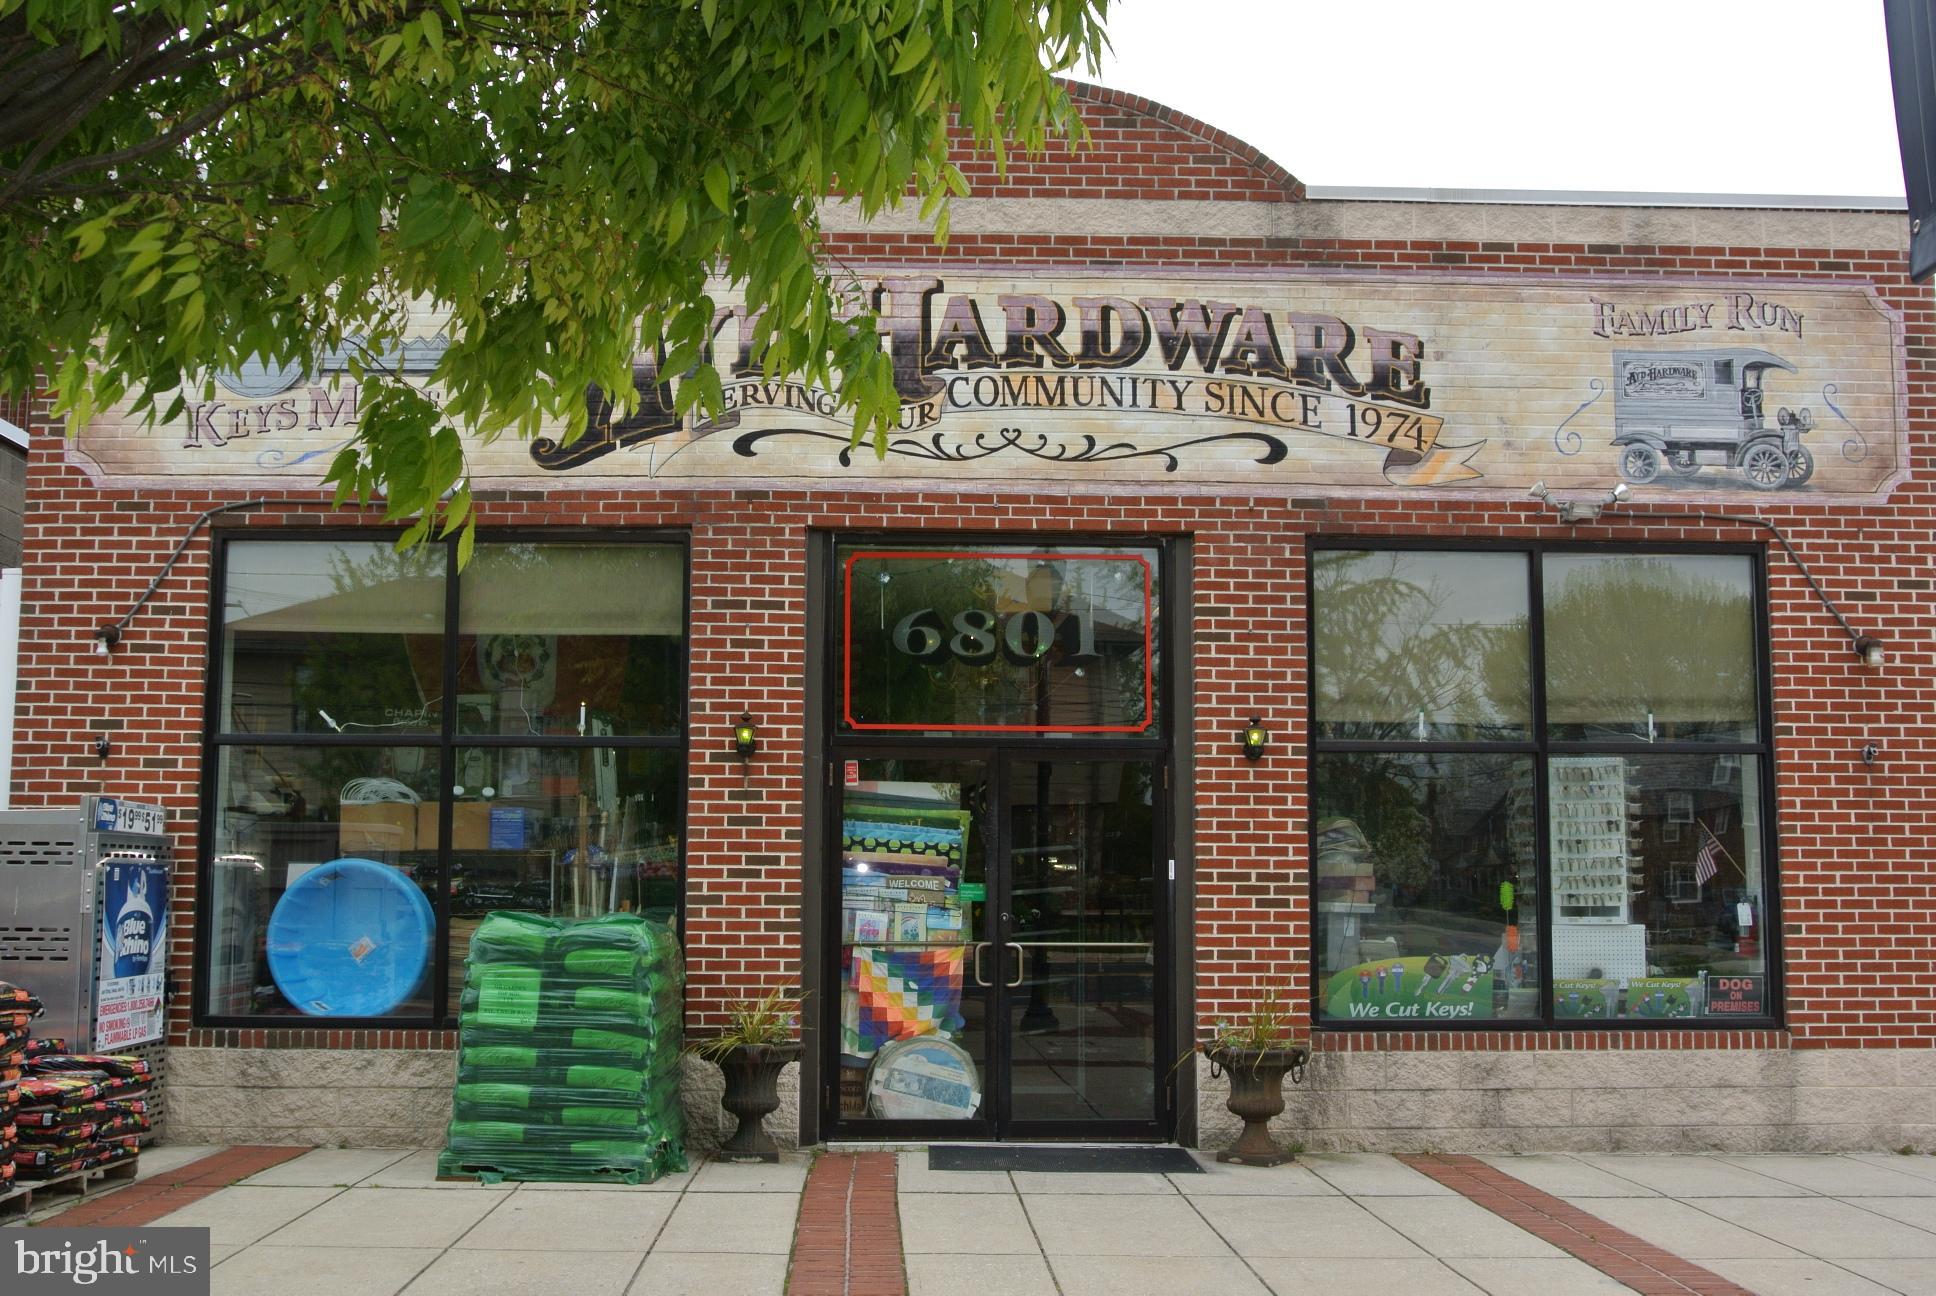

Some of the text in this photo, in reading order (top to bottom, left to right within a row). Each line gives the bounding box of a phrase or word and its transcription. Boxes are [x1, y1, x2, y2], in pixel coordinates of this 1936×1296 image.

[1590, 292, 1805, 339] FAMILY RUN
[832, 274, 1430, 408] HARDWARE
[1647, 367, 1698, 381] HARDWARE
[701, 375, 1428, 452] ERVING UR COMMUNITY SINCE 1974
[184, 397, 298, 448] KEYS
[892, 607, 1104, 662] 6801
[889, 879, 940, 891] WELCOME
[123, 918, 146, 936] Blue
[1559, 981, 1574, 989] Cut
[1662, 981, 1681, 989] Keys!
[1719, 979, 1754, 990] DOG
[1730, 992, 1744, 1000] ON
[1350, 1001, 1474, 1019] We Cut Keys!
[1711, 1001, 1760, 1012] PREMISES
